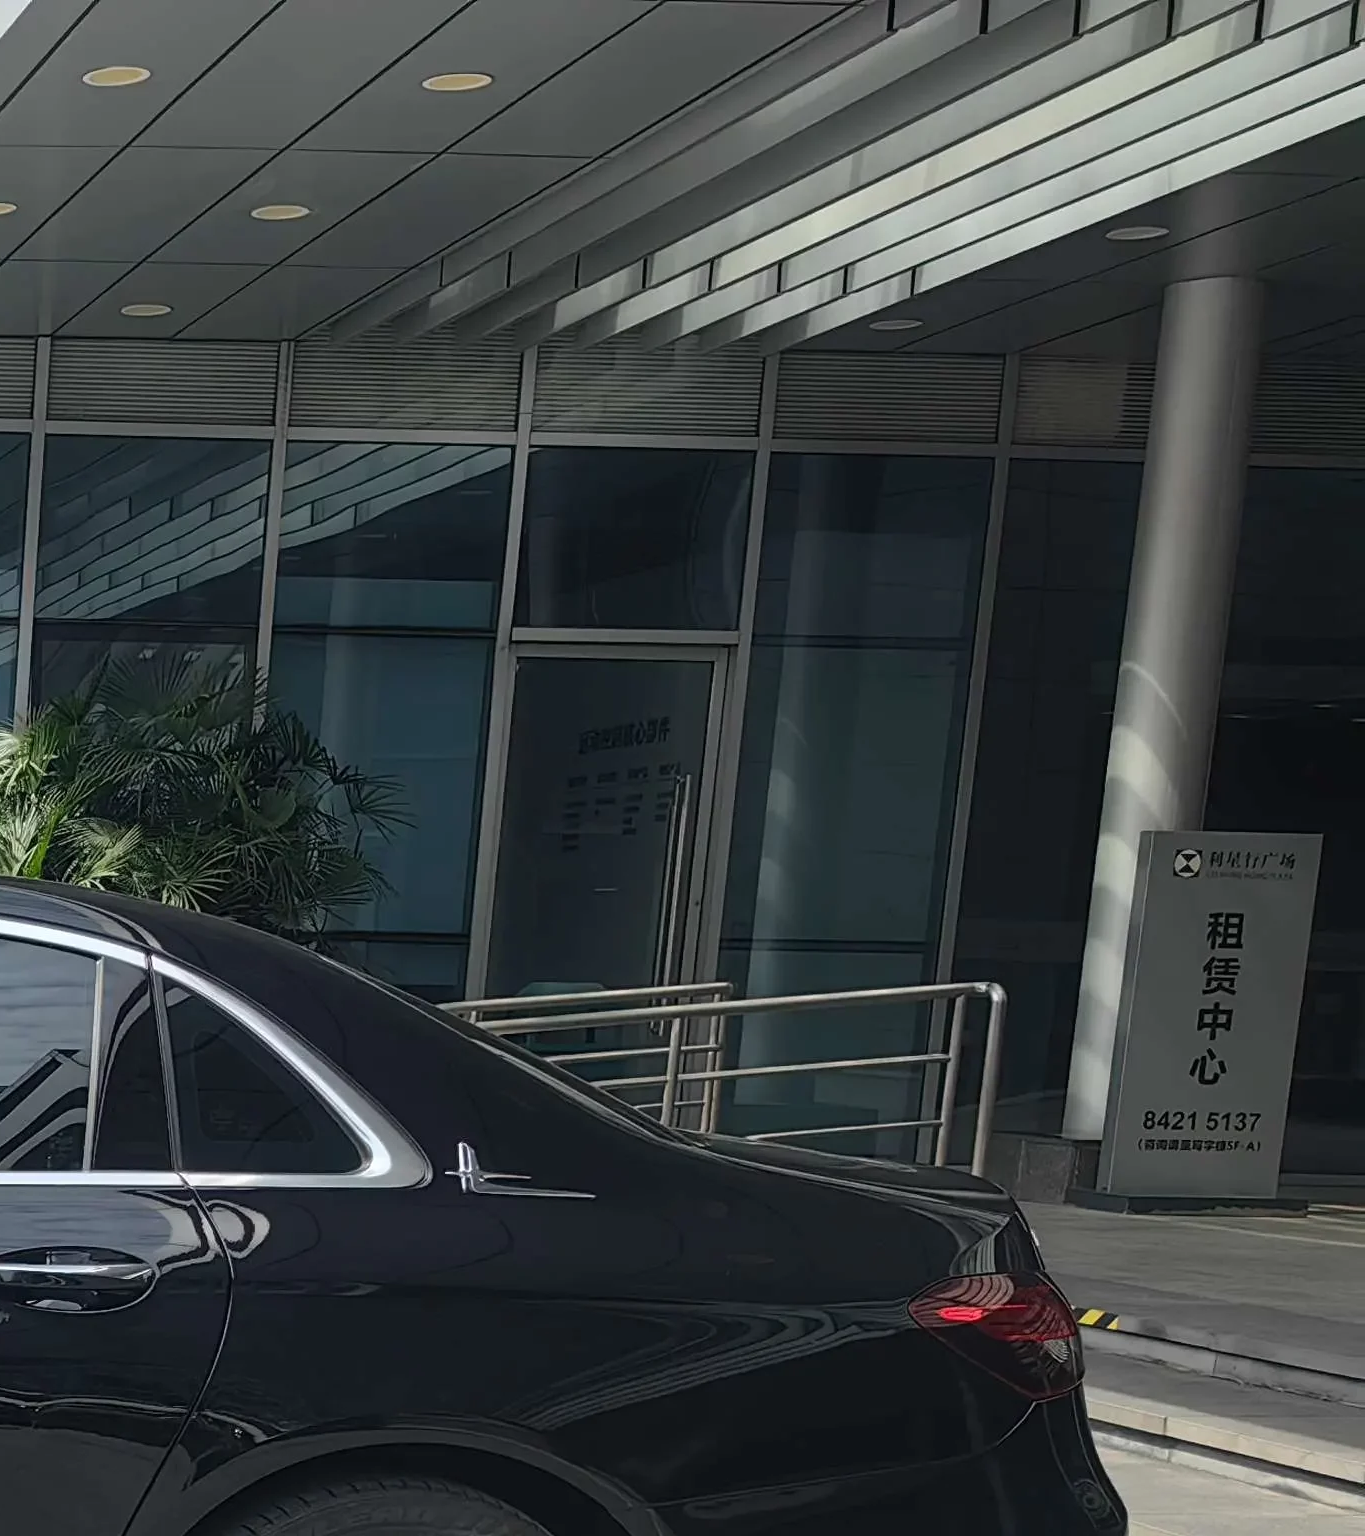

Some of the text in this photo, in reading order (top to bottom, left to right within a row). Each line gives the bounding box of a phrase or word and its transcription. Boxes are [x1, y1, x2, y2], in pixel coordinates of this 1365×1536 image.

[1188, 911, 1245, 1086] 租赁中心
[1142, 1110, 1262, 1132] 8421 5137
